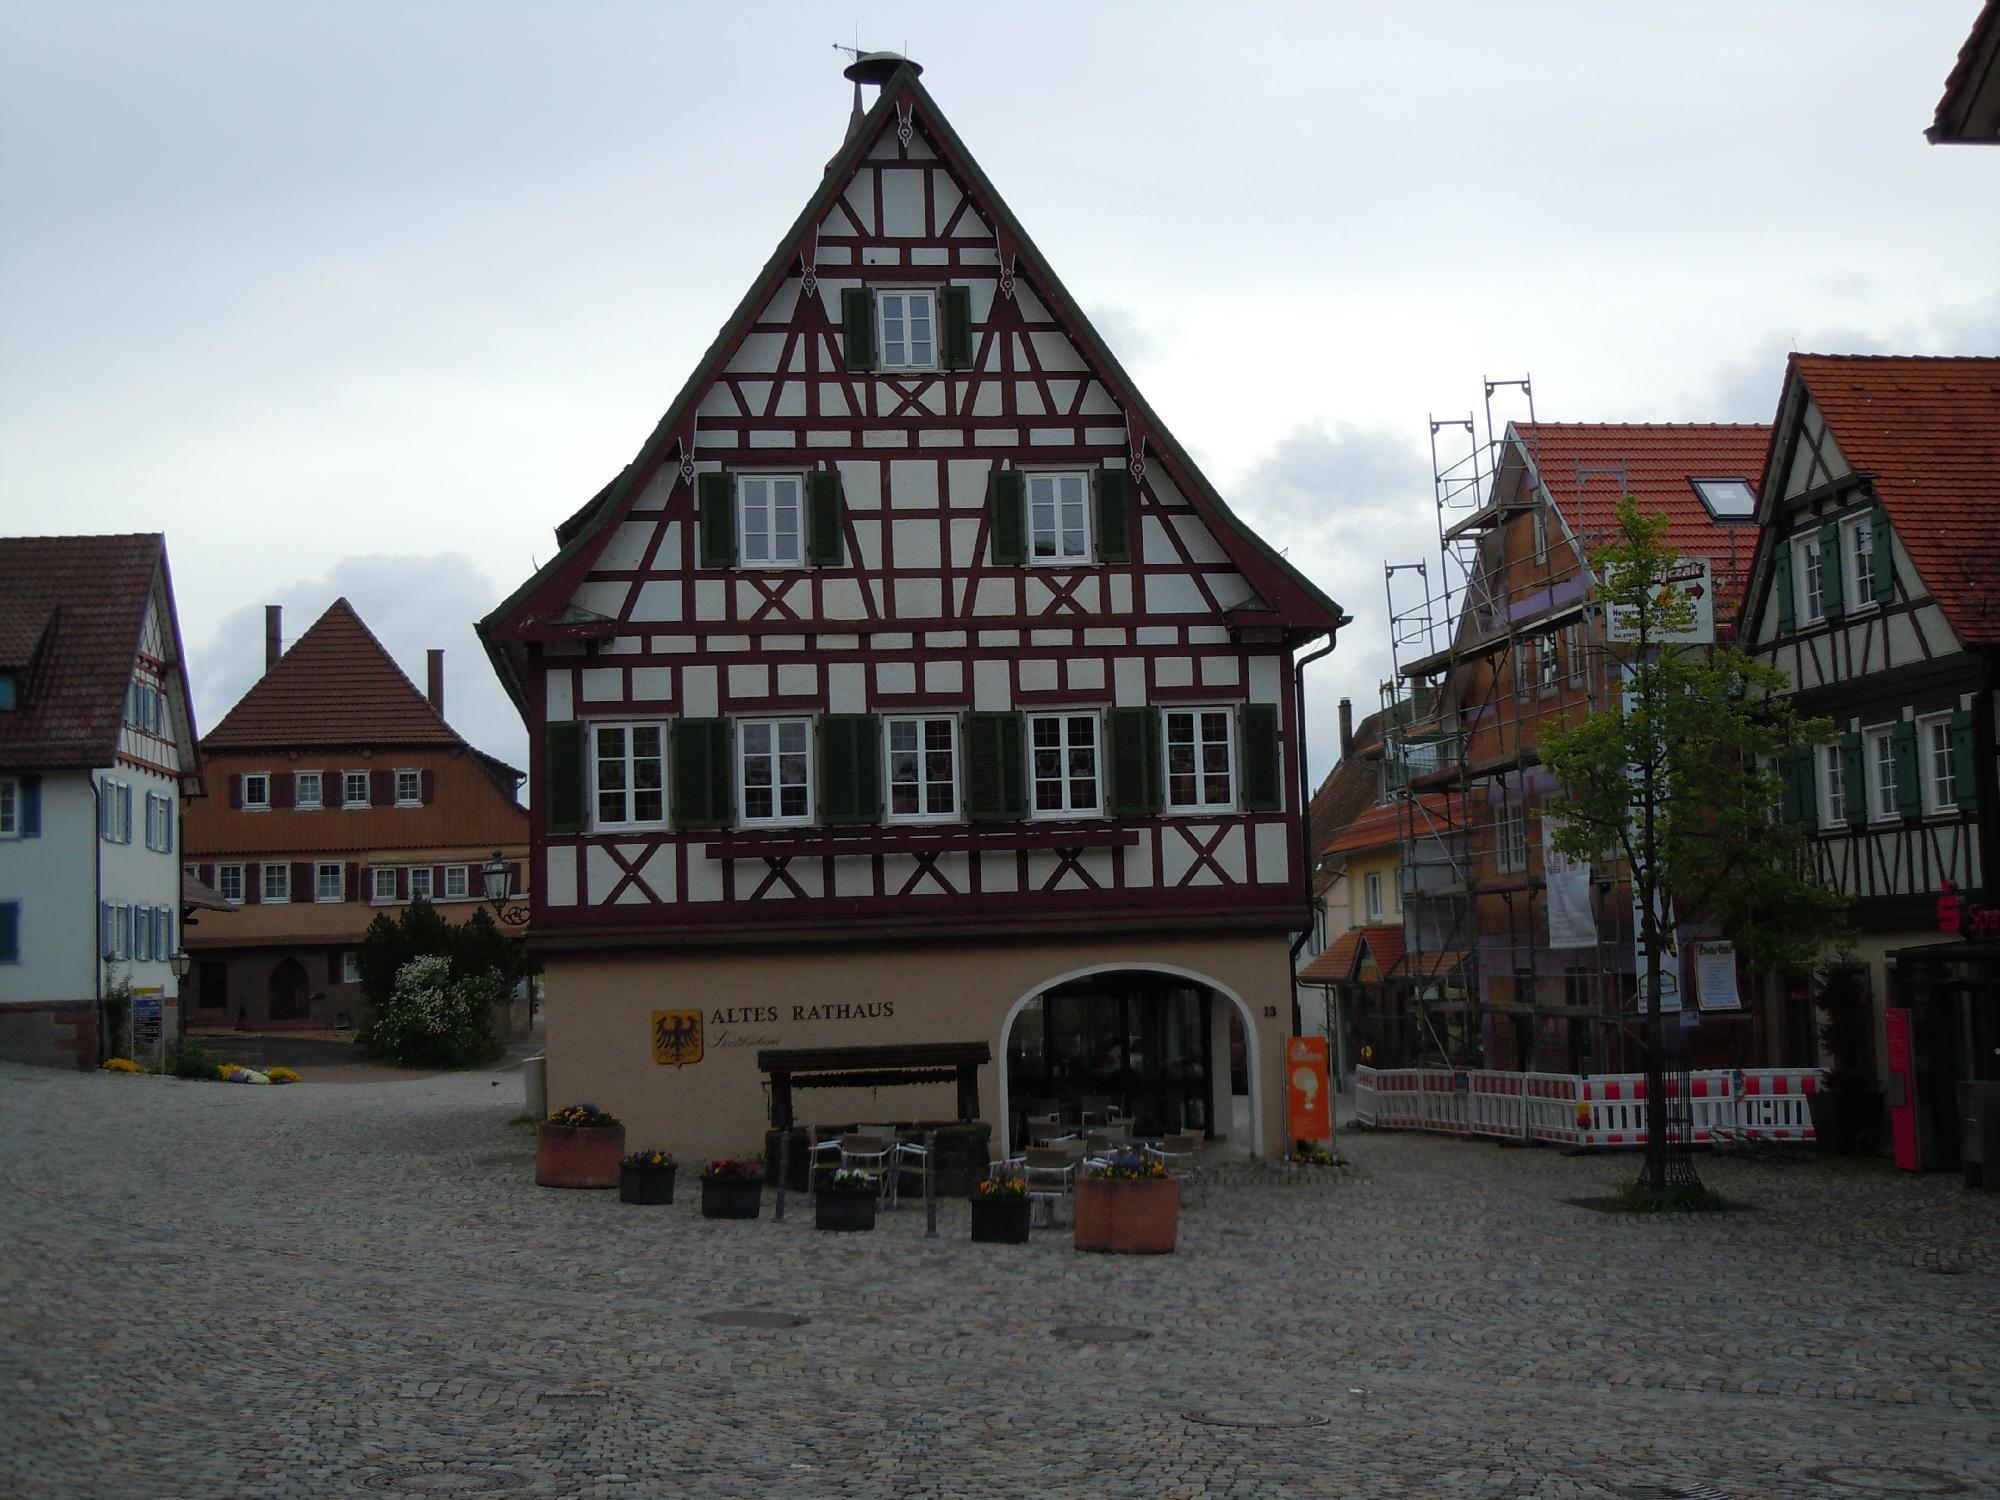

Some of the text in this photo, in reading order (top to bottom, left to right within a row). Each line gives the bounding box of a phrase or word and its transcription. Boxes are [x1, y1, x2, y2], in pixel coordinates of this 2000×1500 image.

[710, 1001, 895, 1025] ALTES RATHAUS
[1263, 1005, 1277, 1017] 13
